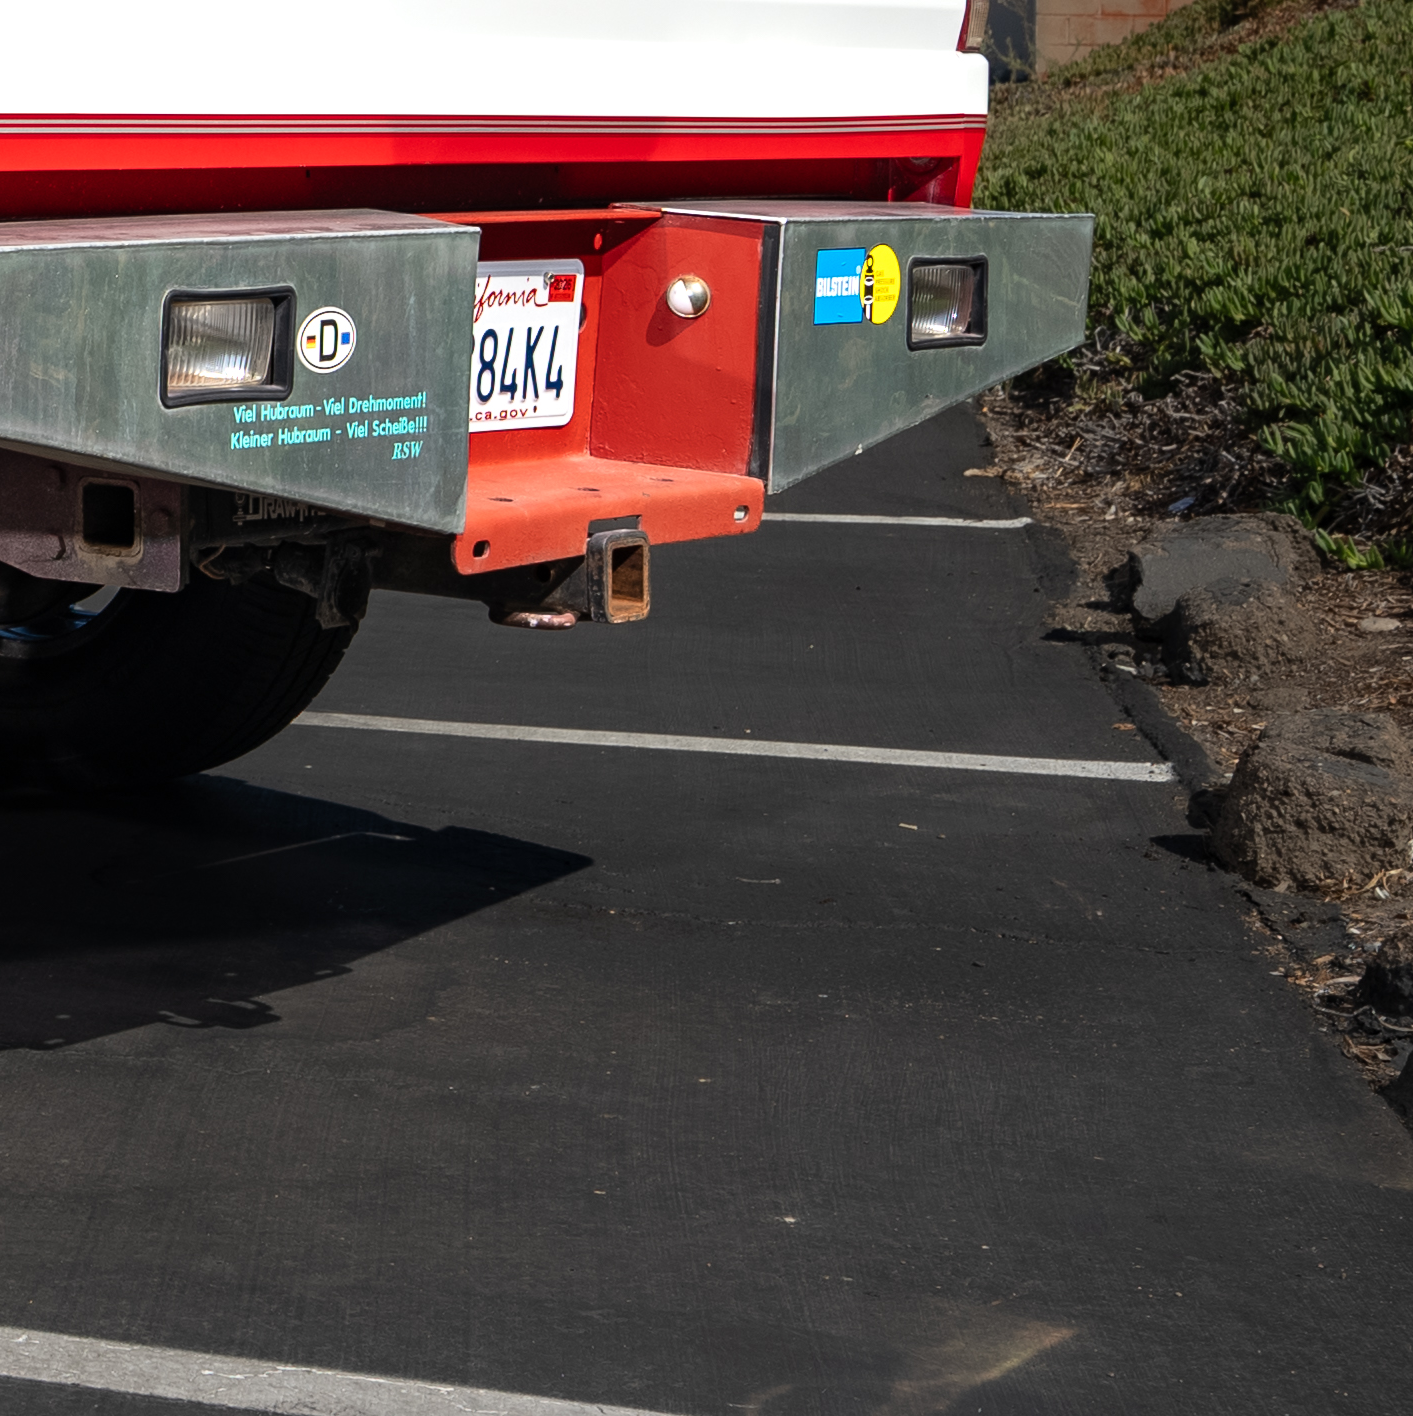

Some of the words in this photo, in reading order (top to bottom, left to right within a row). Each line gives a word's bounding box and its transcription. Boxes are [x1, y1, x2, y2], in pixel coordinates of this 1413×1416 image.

[816, 275, 860, 298] BILSTEIN
[319, 319, 338, 363] D
[473, 325, 564, 404] 84K4
[233, 405, 257, 424] Viel
[260, 402, 314, 422] Hubraum
[323, 397, 345, 416] Viel
[348, 391, 427, 414] Drehmoment!
[230, 430, 274, 450] Kleiner
[278, 426, 331, 445] Hubraum
[346, 420, 369, 439] Viel
[372, 416, 428, 437] Scheiße!!!
[392, 440, 424, 460] RSW
